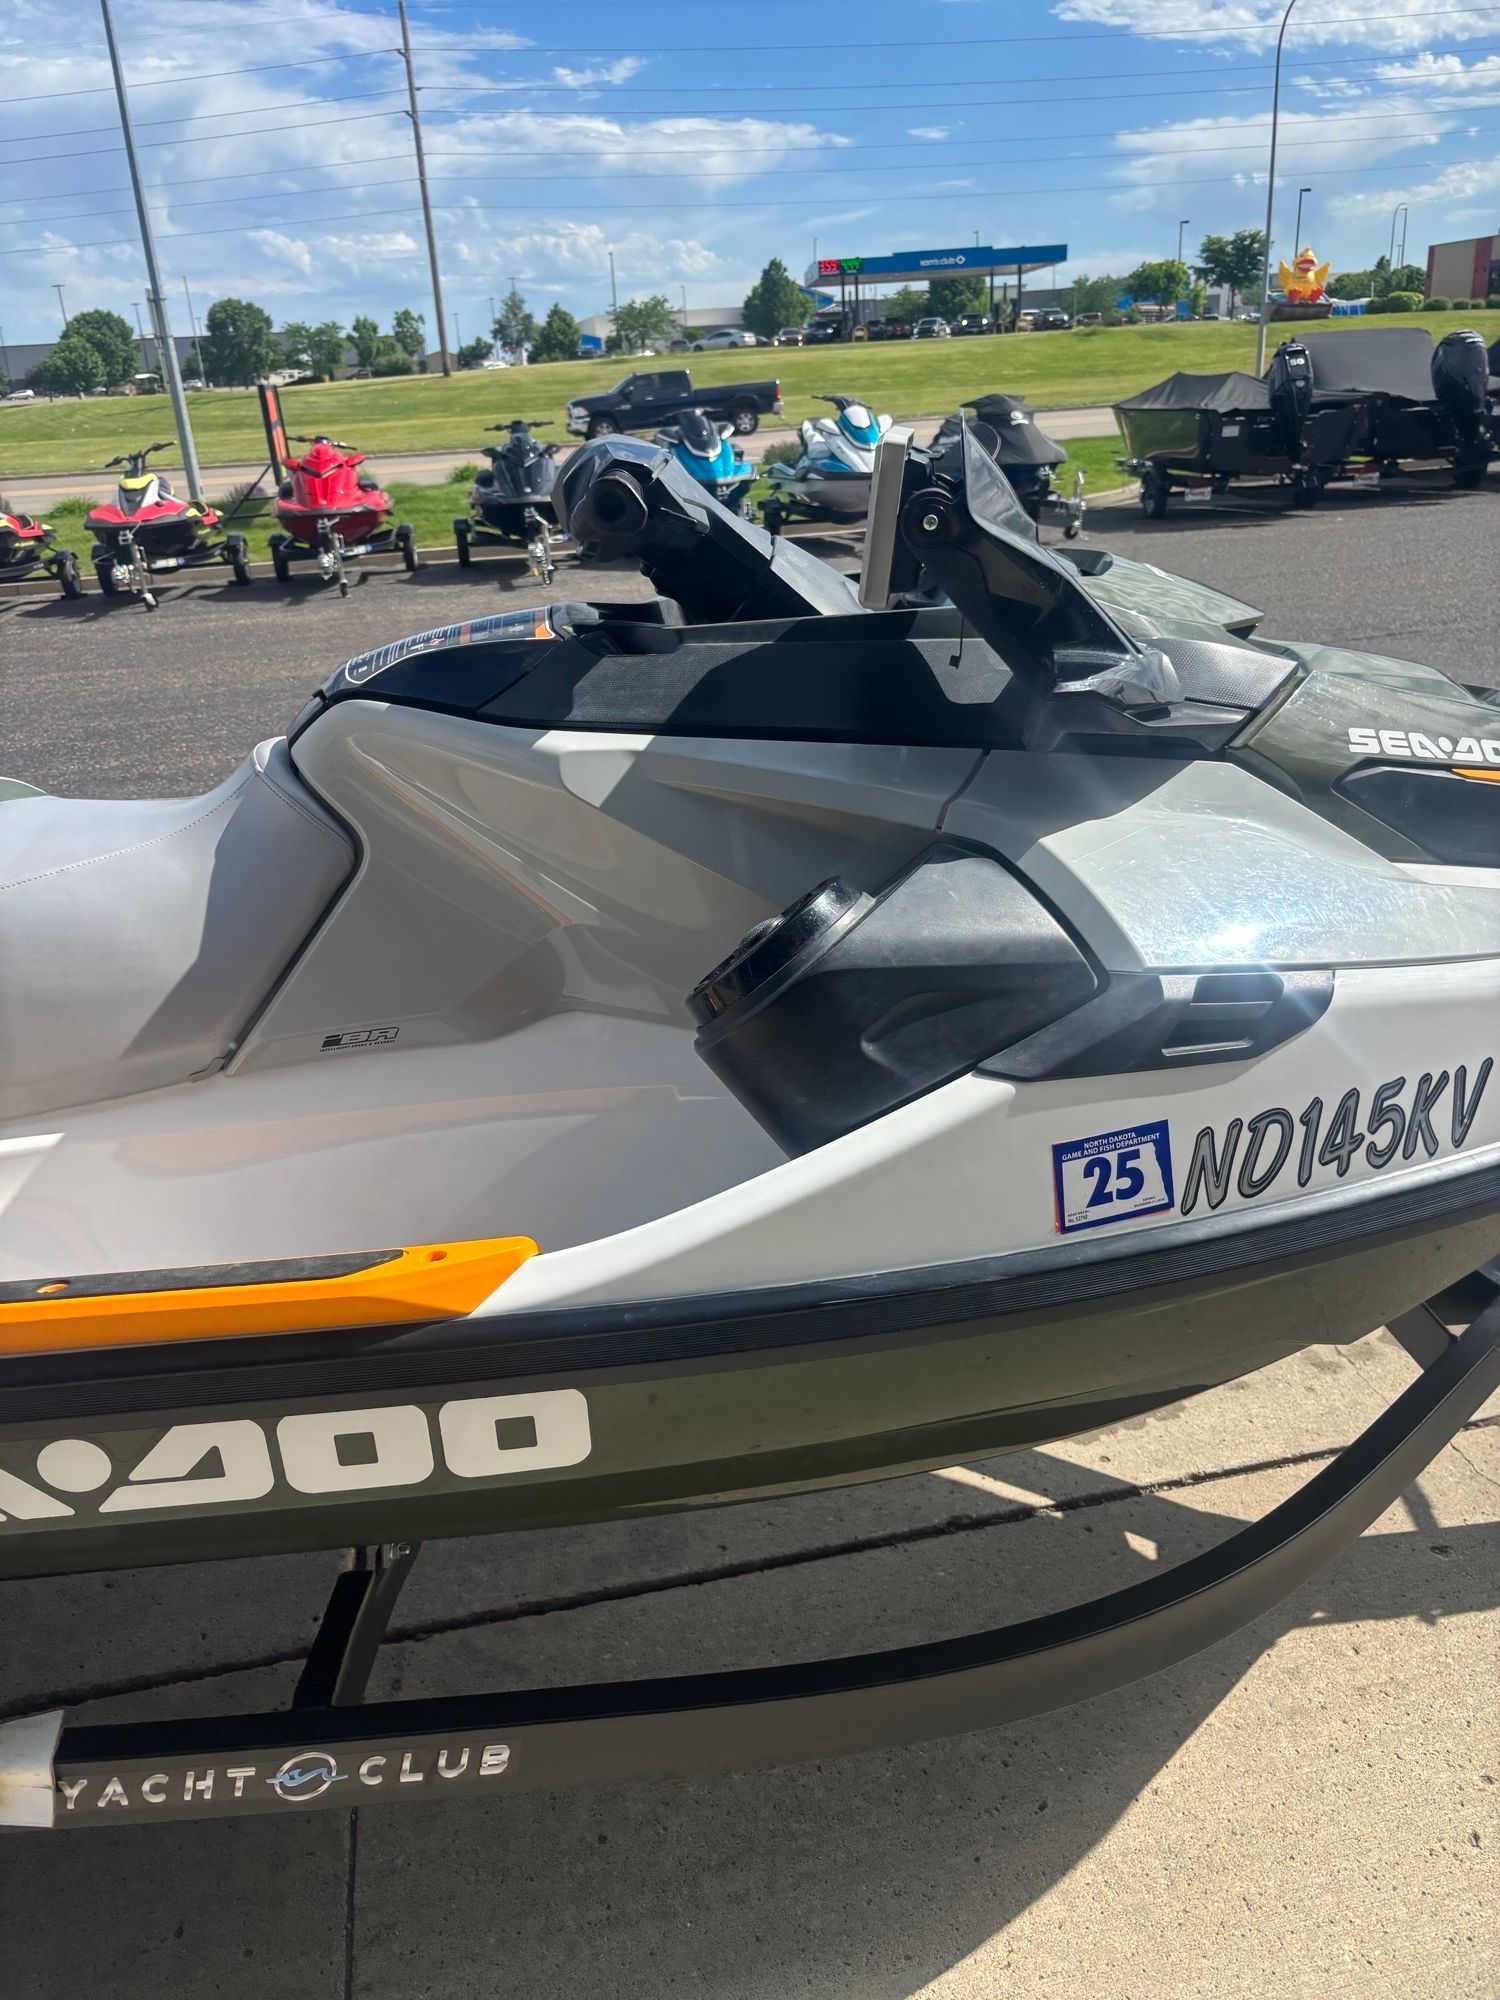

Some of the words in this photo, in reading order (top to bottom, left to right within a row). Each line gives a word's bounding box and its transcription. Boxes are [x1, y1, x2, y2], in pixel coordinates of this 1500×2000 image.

[1062, 1151, 1082, 1161] GAME
[1083, 1147, 1098, 1156] AND
[1099, 1143, 1115, 1152] FISH
[1116, 1132, 1160, 1148] DEPARTMENT
[1084, 1138, 1108, 1149] NORTH
[1109, 1132, 1136, 1143] DAKOTA
[1083, 1149, 1145, 1208] 25
[56, 1767, 256, 1810] YACHT
[358, 1744, 511, 1786] CLUB
